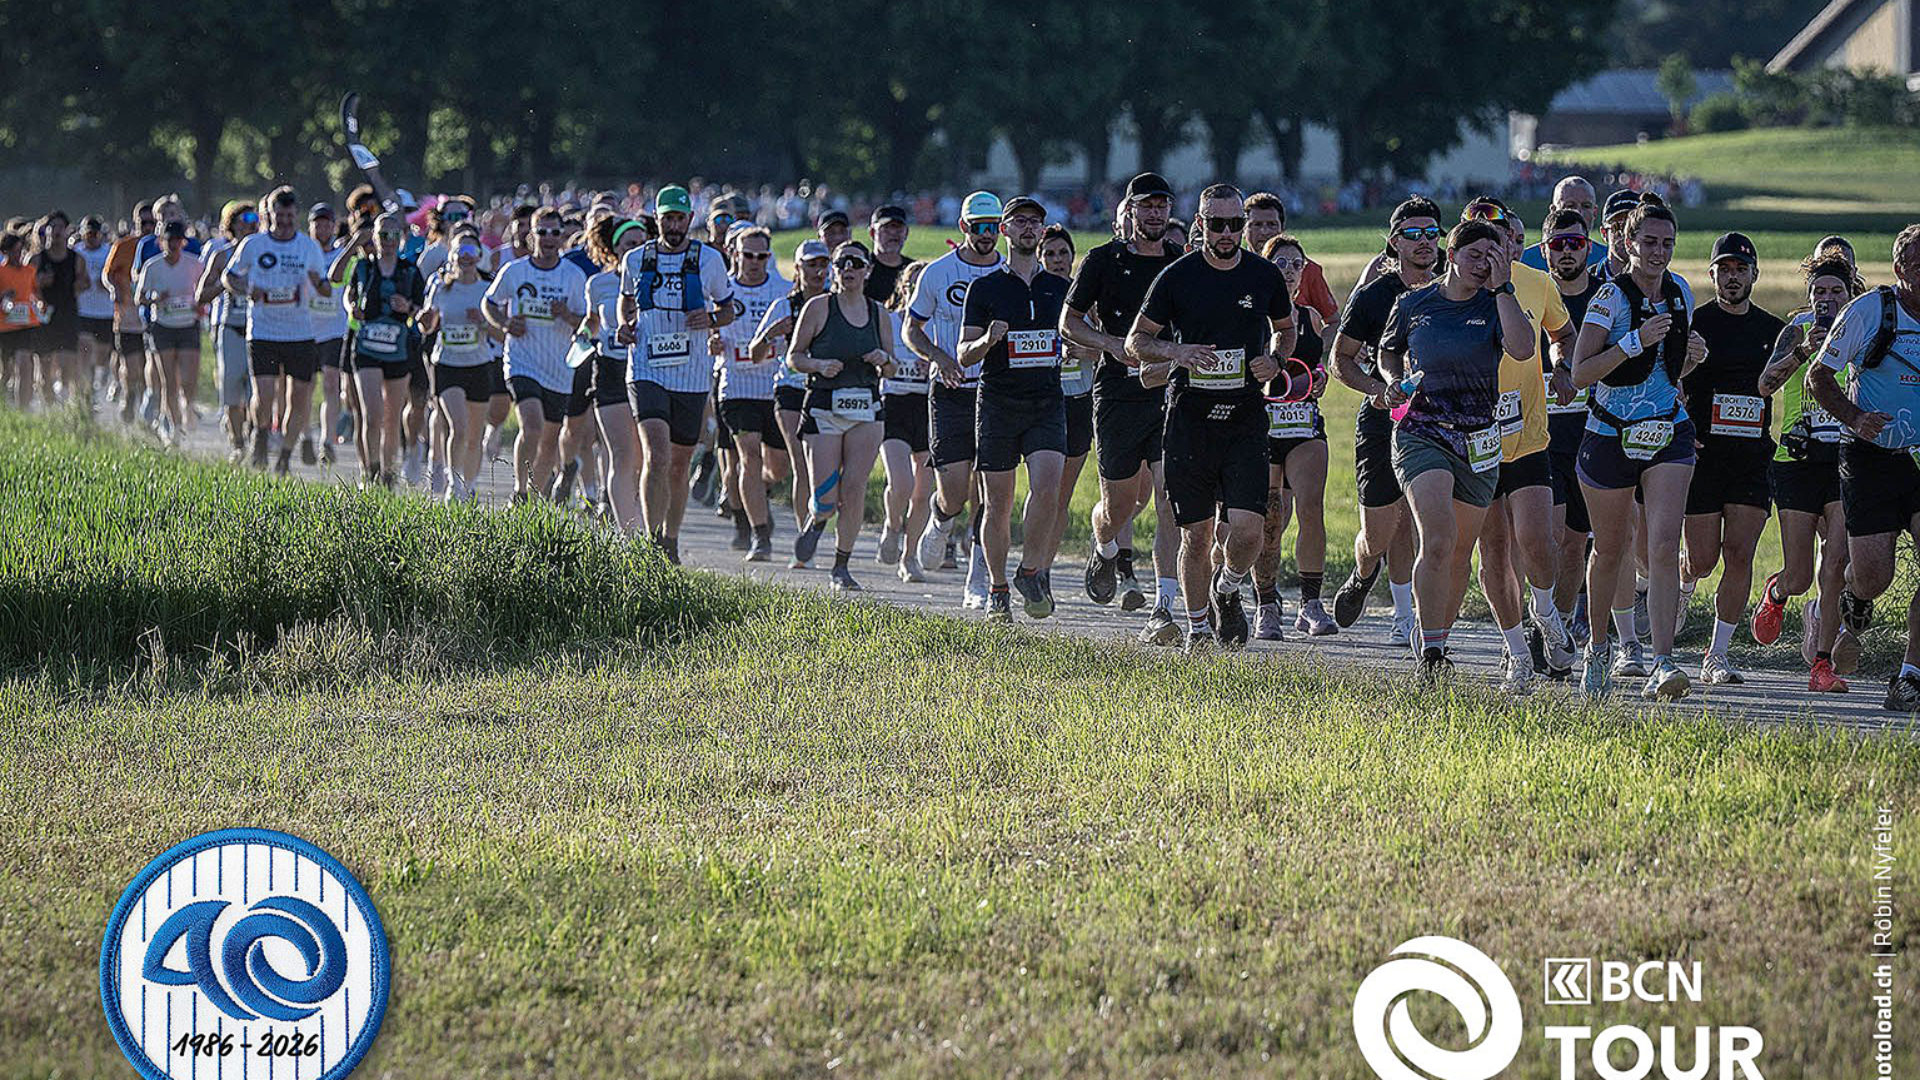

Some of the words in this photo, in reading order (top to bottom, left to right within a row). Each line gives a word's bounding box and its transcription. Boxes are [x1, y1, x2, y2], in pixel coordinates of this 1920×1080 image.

[657, 341, 681, 352] 6606
[1021, 340, 1047, 350] 2910
[1212, 360, 1234, 372] 216
[837, 398, 869, 410] 26975
[1280, 410, 1306, 421] 4015
[1727, 406, 1755, 419] 2576
[1635, 430, 1663, 444] 4248
